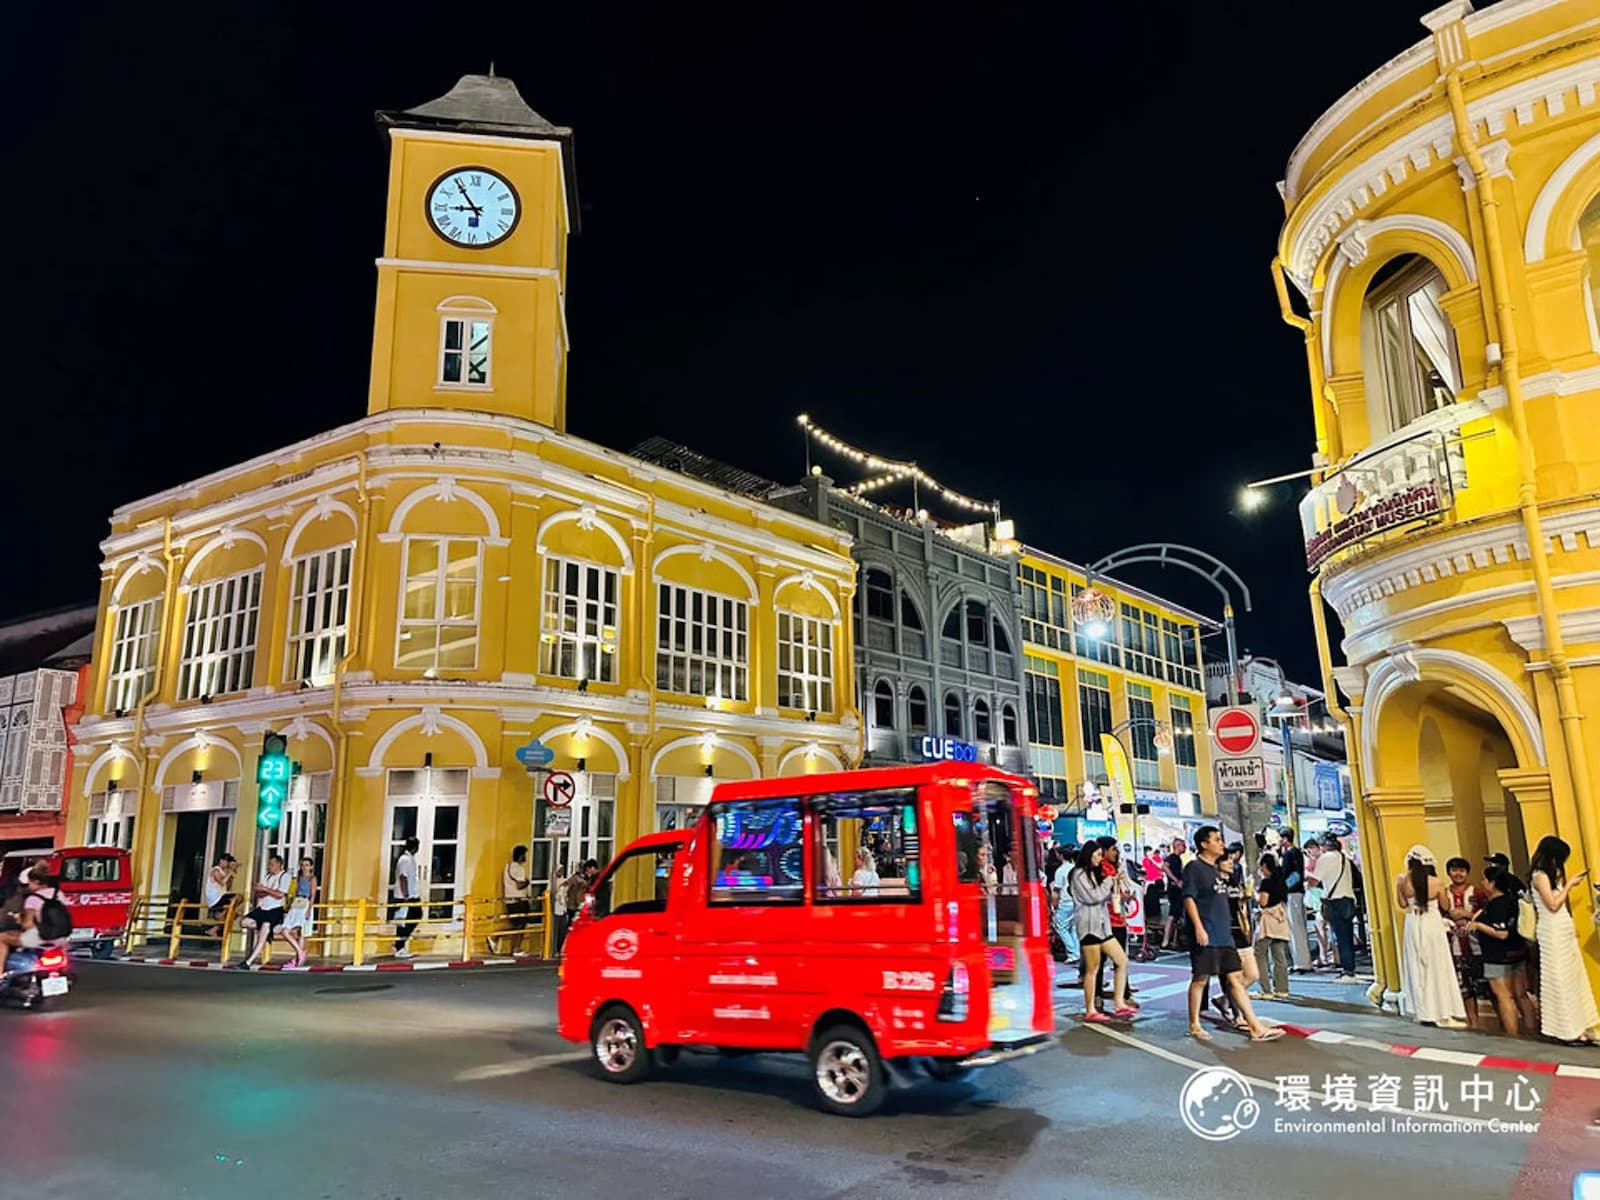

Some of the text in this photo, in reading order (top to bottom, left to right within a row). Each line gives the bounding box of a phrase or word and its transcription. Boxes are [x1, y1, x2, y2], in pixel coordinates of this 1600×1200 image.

[1376, 498, 1439, 528] MUSEUM
[262, 760, 285, 779] 23
[1219, 760, 1261, 777] ห้ามเข้า
[1236, 780, 1258, 788] ENTRY
